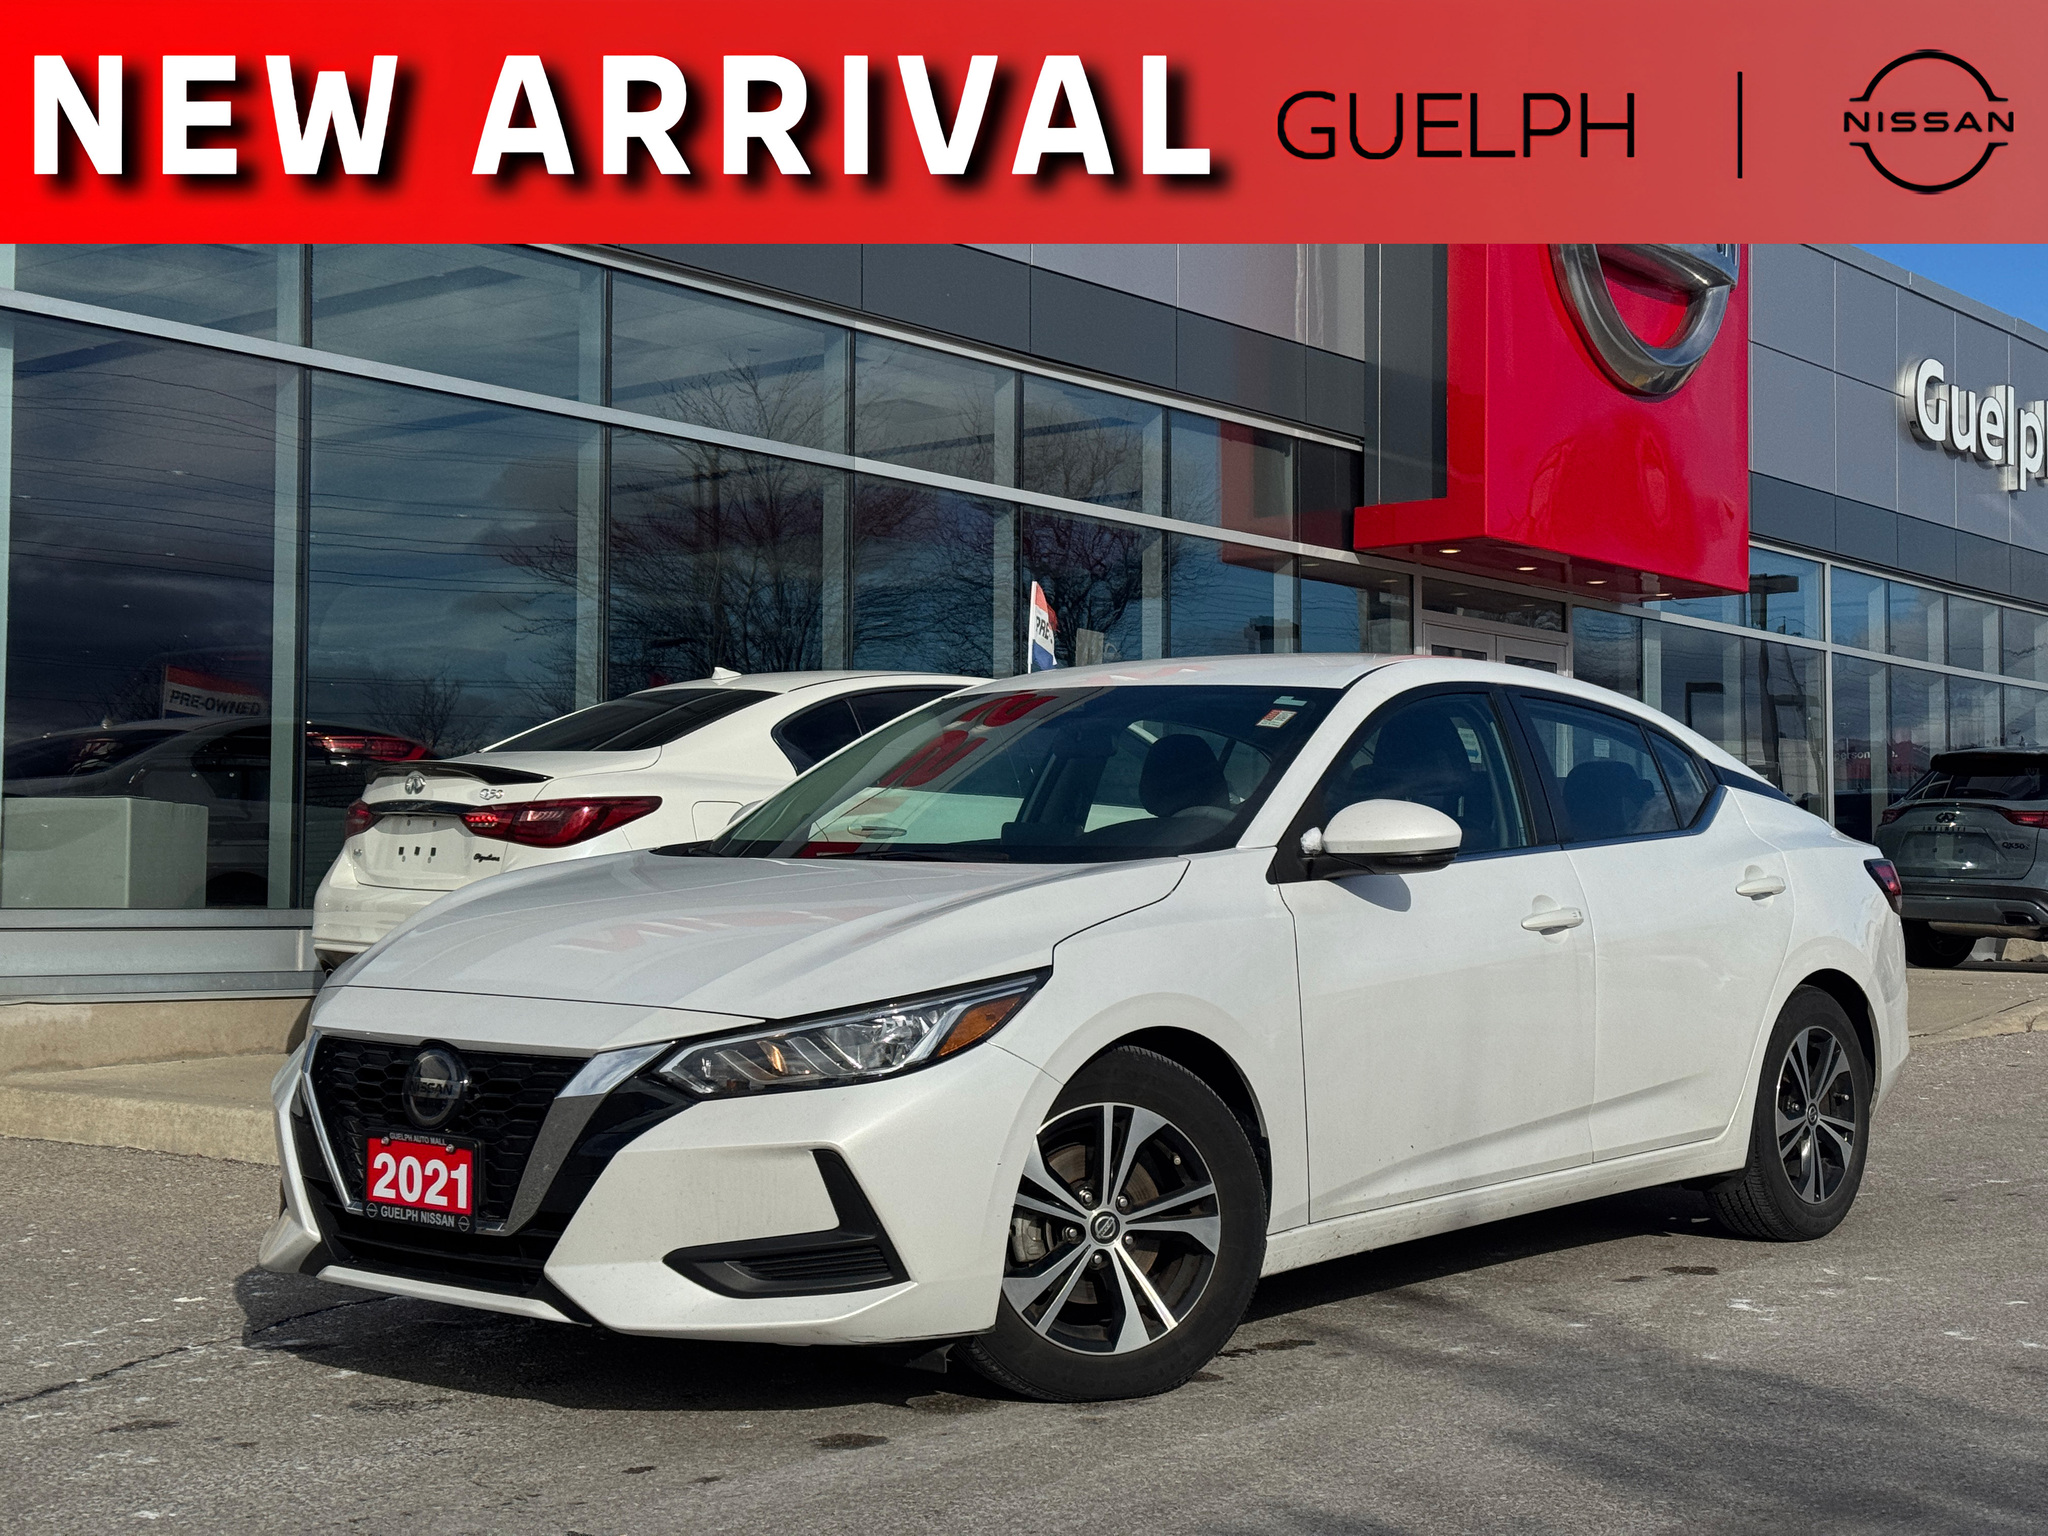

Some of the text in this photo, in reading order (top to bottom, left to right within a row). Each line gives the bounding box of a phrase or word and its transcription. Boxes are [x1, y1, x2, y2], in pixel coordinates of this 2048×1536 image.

[1906, 358, 2048, 492] Guelp
[168, 689, 261, 715] PRE-OWNED
[389, 1132, 447, 1146] GUELPH AUTO MALL
[373, 1152, 468, 1209] 2021
[380, 1205, 455, 1228] GUELPH NISSAN
